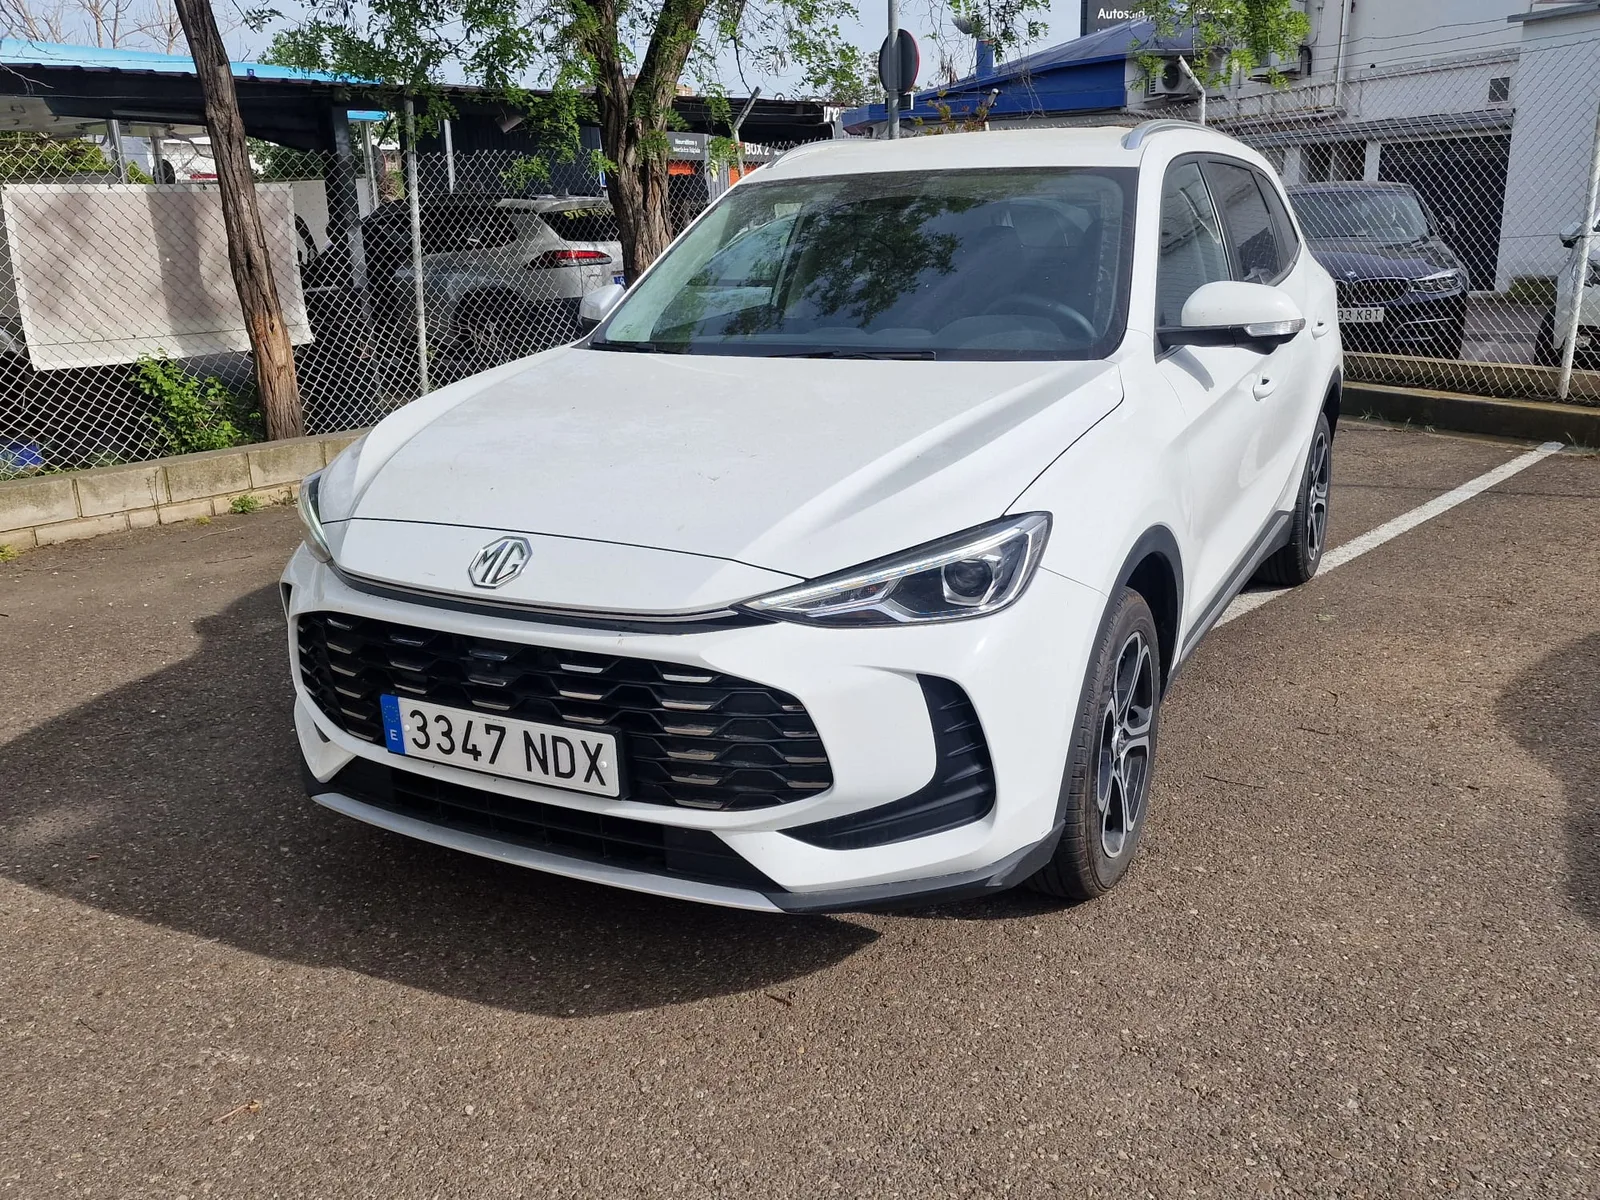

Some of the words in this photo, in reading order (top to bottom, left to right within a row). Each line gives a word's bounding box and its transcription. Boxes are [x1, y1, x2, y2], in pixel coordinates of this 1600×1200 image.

[744, 142, 761, 155] BOX
[1356, 308, 1381, 321] KBT
[471, 538, 528, 586] MG
[390, 729, 399, 741] E
[409, 709, 507, 765] 3347
[523, 730, 607, 787] NDX
